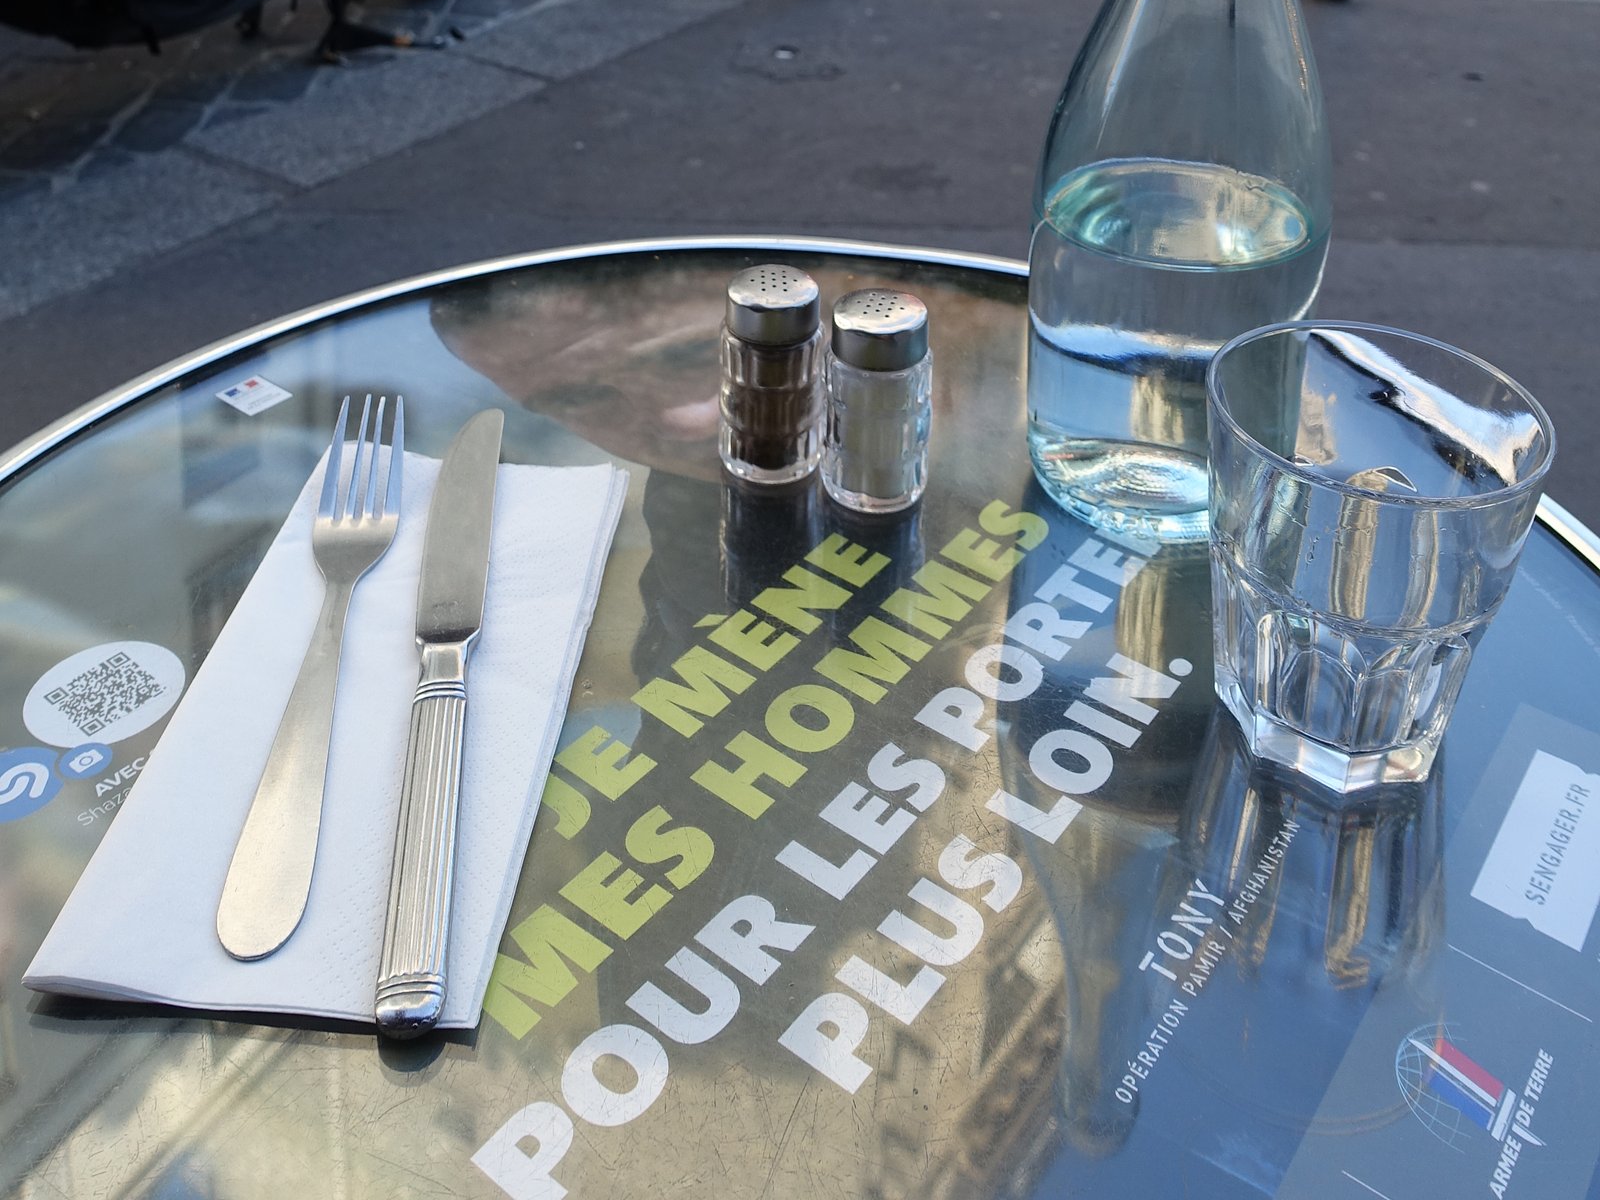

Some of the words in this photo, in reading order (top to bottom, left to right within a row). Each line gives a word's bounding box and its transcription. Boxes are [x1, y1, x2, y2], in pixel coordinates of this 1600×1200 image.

[541, 725, 658, 840] JE
[630, 532, 893, 738] MÈNE
[95, 756, 145, 797] AVEC
[483, 804, 715, 1041] MES
[690, 499, 1049, 820] HOMMES
[777, 833, 1023, 1095] PLUS
[984, 652, 1193, 845] LOIN.
[1524, 783, 1591, 906] SENGAGER.FR
[469, 895, 817, 1200] POUR
[774, 742, 946, 901] LES
[1114, 999, 1189, 1104] OPÉRATION
[1182, 939, 1226, 997] PAMIR
[1228, 818, 1301, 926] AFGHANISTAN
[1138, 878, 1225, 981] TONY
[1515, 1098, 1536, 1128] DE
[1523, 1048, 1554, 1102] TERRE
[1489, 1135, 1523, 1200] ARMEE
